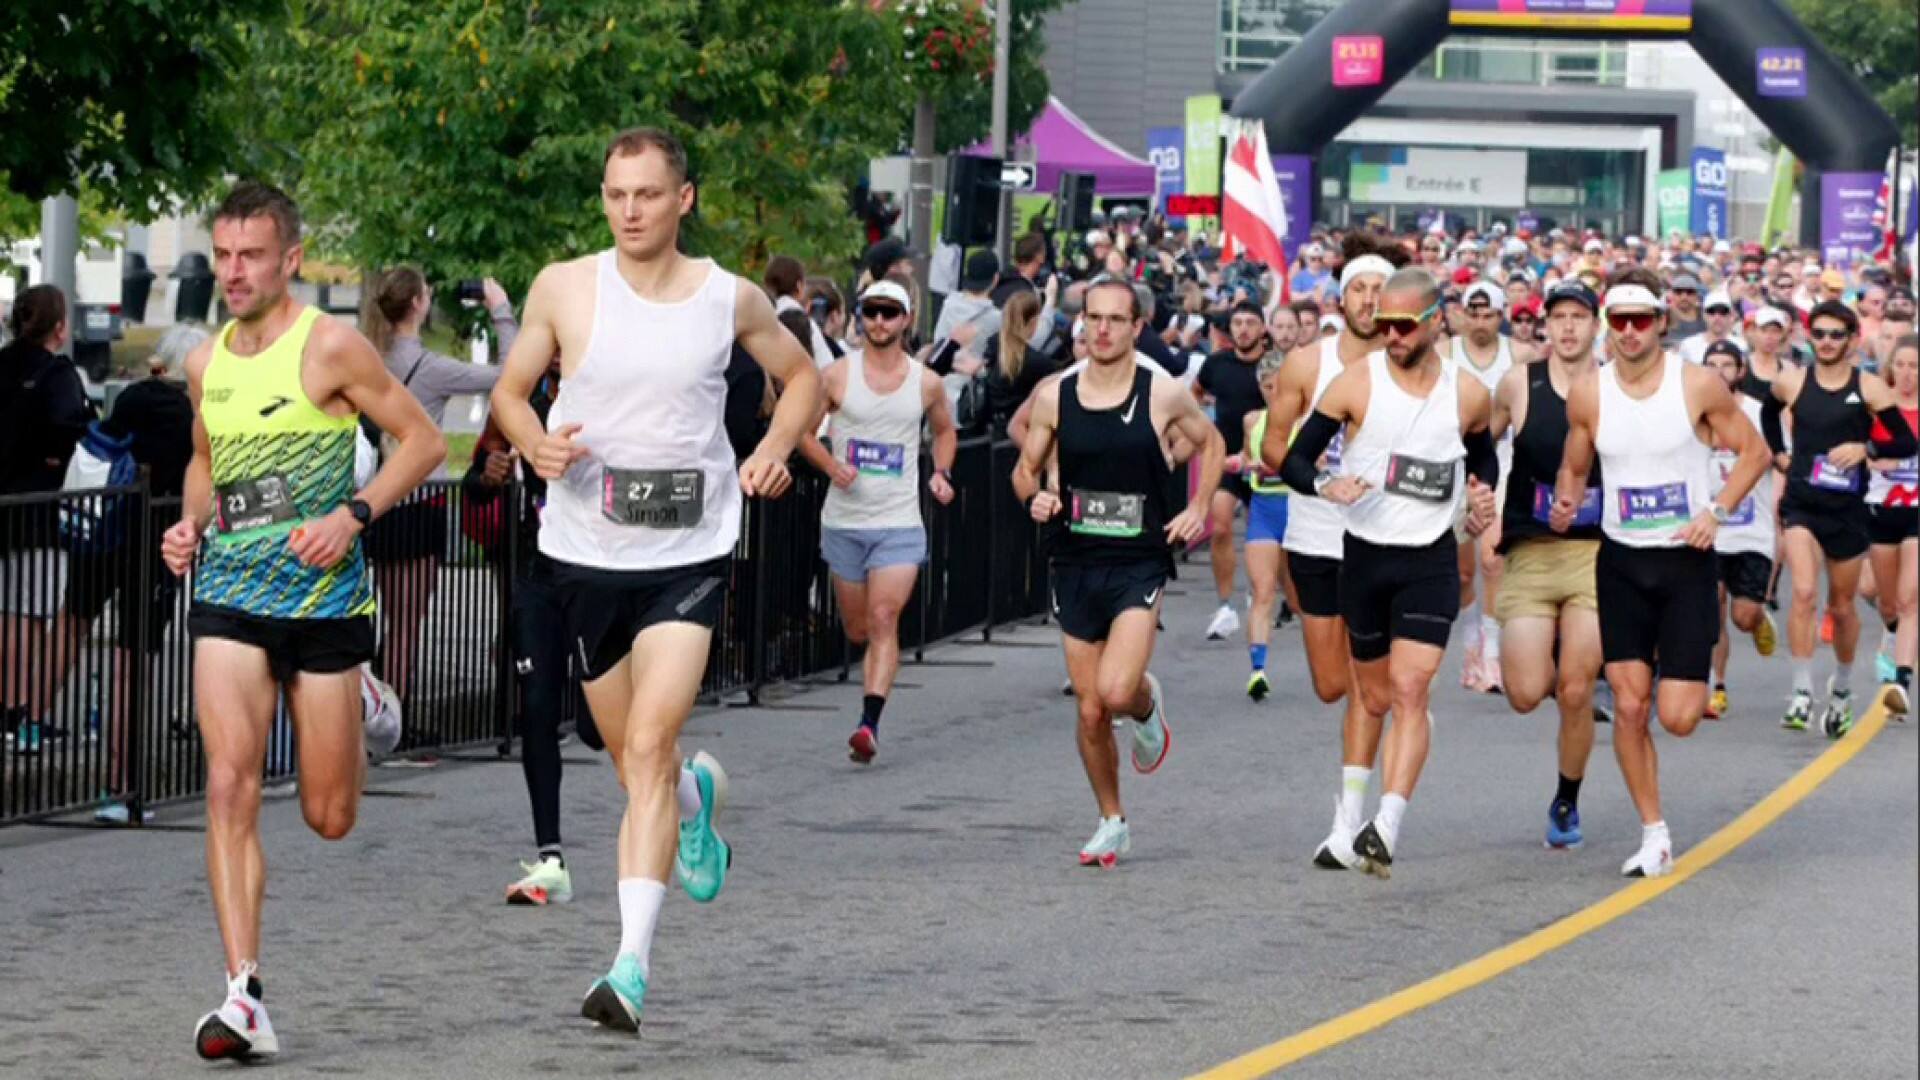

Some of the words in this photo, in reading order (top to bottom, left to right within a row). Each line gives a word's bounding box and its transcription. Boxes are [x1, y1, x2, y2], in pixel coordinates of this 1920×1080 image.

[628, 481, 655, 501] 27
[227, 493, 246, 514] 23
[1088, 499, 1106, 515] 25
